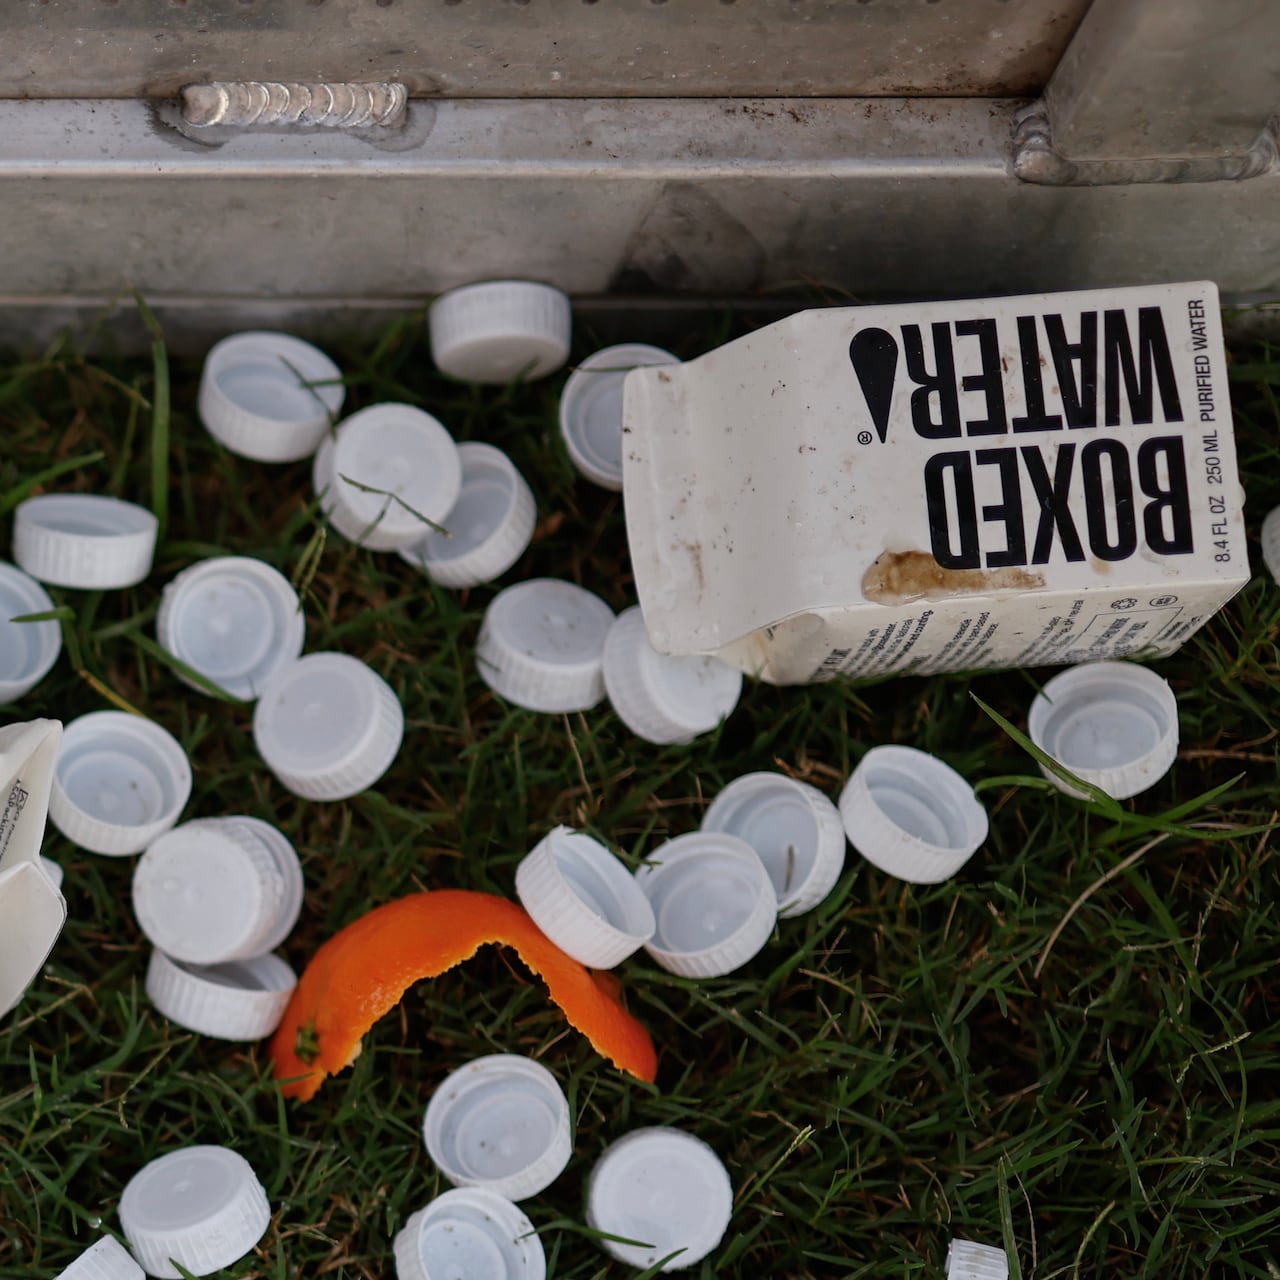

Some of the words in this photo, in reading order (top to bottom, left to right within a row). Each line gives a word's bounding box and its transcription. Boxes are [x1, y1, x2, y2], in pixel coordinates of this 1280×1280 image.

[1186, 298, 1208, 351] WATER
[900, 306, 1184, 439] WATER
[1193, 354, 1216, 422] PURIFIED
[1201, 428, 1219, 452] ML
[1204, 455, 1223, 484] 250
[924, 435, 1194, 570] BOXED
[1207, 494, 1226, 514] OZ
[1210, 516, 1228, 535] FL
[1212, 539, 1231, 562] 8.4
